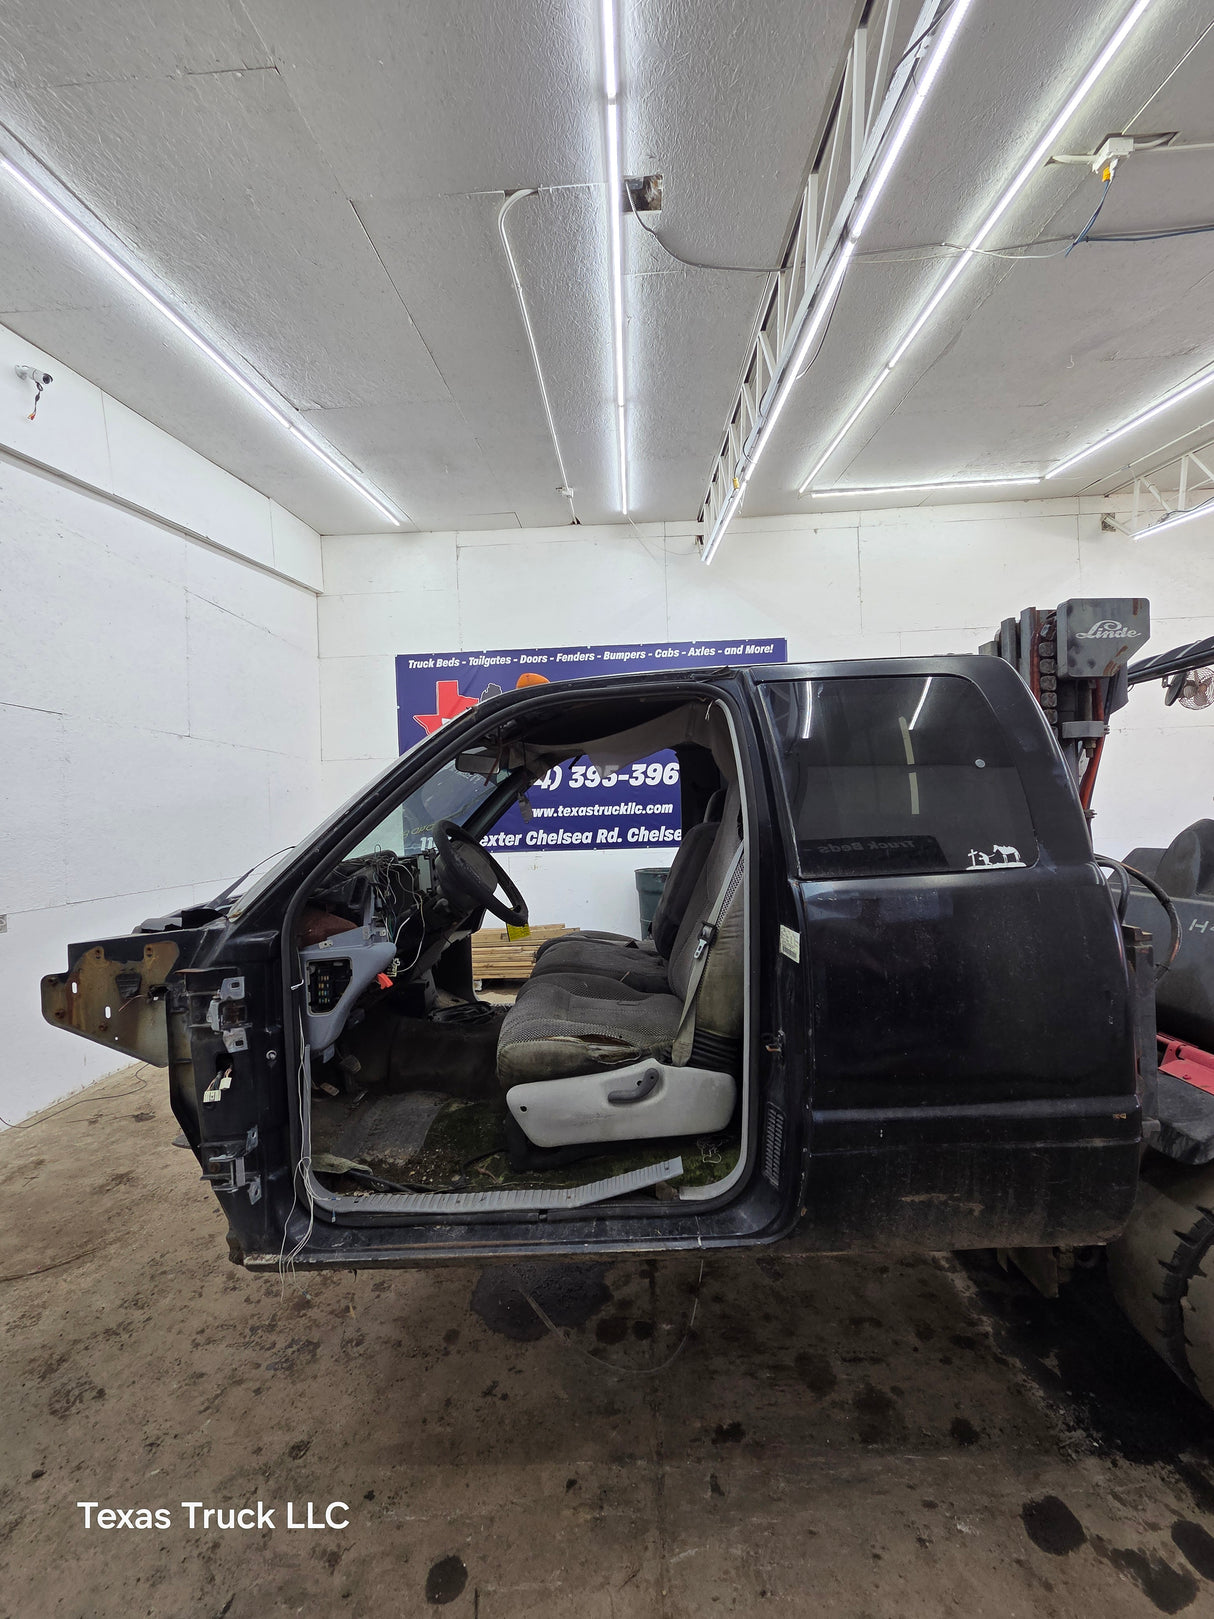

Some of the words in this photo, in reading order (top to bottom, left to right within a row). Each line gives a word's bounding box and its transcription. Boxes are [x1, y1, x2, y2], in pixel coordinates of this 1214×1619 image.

[1075, 620, 1141, 638] Linde
[408, 659, 434, 669] Truck
[436, 657, 460, 668] Beds
[468, 655, 512, 668] Tailgates
[520, 654, 548, 664] Doors
[556, 651, 596, 662] Fenders
[603, 651, 647, 662] Bumpers
[655, 648, 680, 658] Cabs
[688, 646, 716, 657] Axles
[724, 644, 745, 655] and
[745, 644, 775, 654] More!
[525, 828, 593, 846] Chelsea
[595, 827, 623, 844] Rd.
